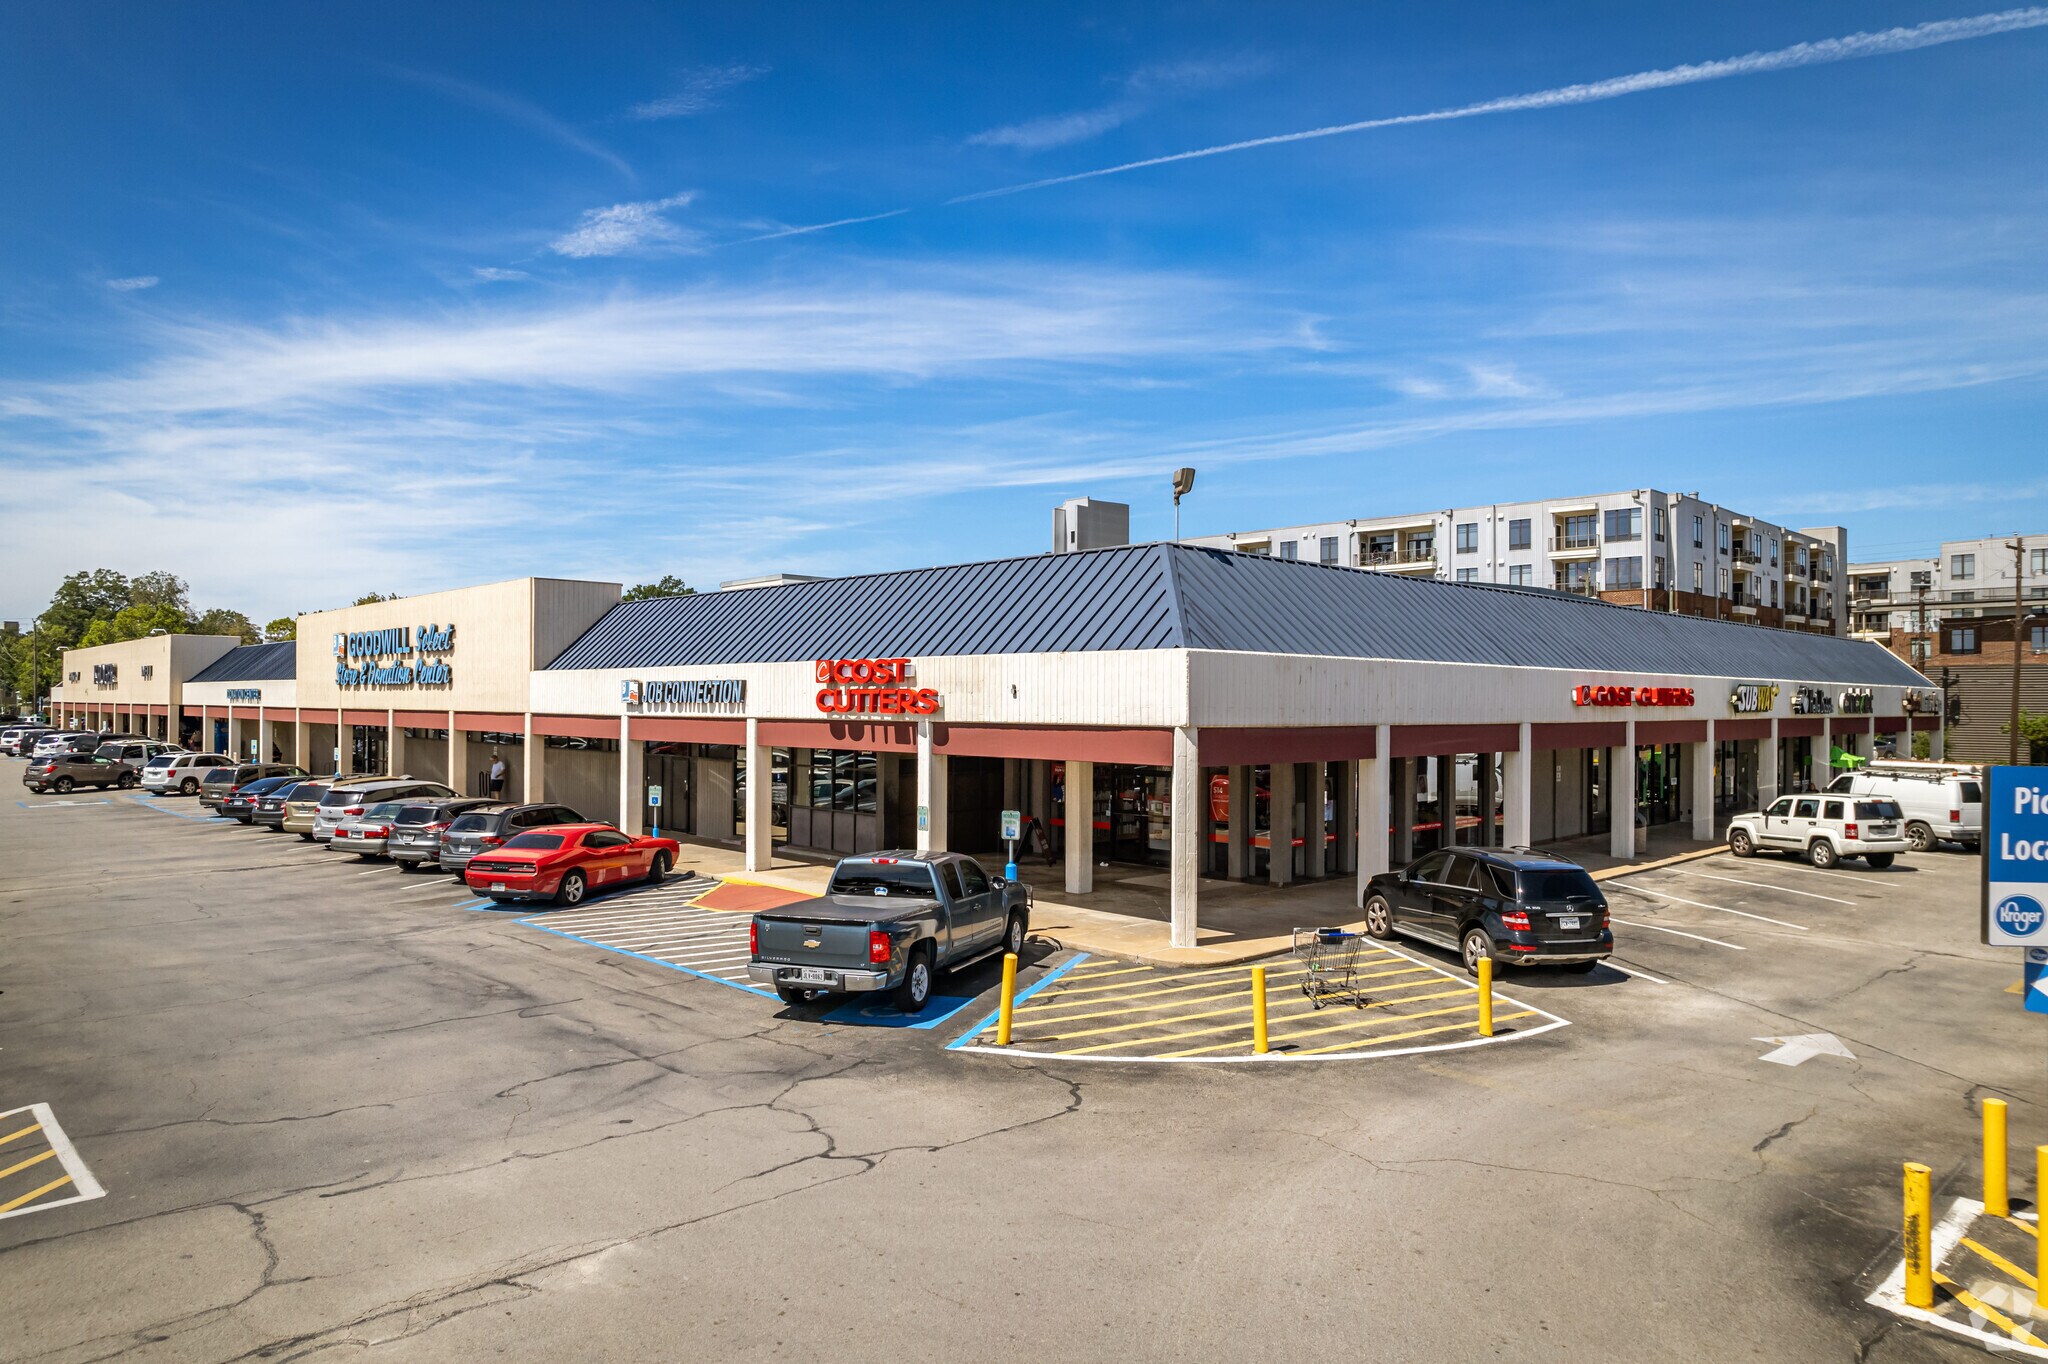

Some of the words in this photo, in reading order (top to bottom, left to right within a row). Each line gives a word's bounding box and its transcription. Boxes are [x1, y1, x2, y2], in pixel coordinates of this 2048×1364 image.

[348, 626, 411, 657] GOODWILL
[416, 623, 454, 652] Select
[335, 662, 359, 686] Store
[360, 661, 367, 685] &
[368, 660, 411, 686] Donation
[414, 658, 450, 685] Center
[834, 658, 910, 685] COST
[642, 681, 663, 704] JOB
[665, 679, 743, 704] CONNECTION
[816, 688, 939, 714] CUTTERS
[1733, 684, 1779, 712] SUBWAY
[2001, 832, 2048, 861] Loc
[2000, 901, 2042, 931] Kroger
